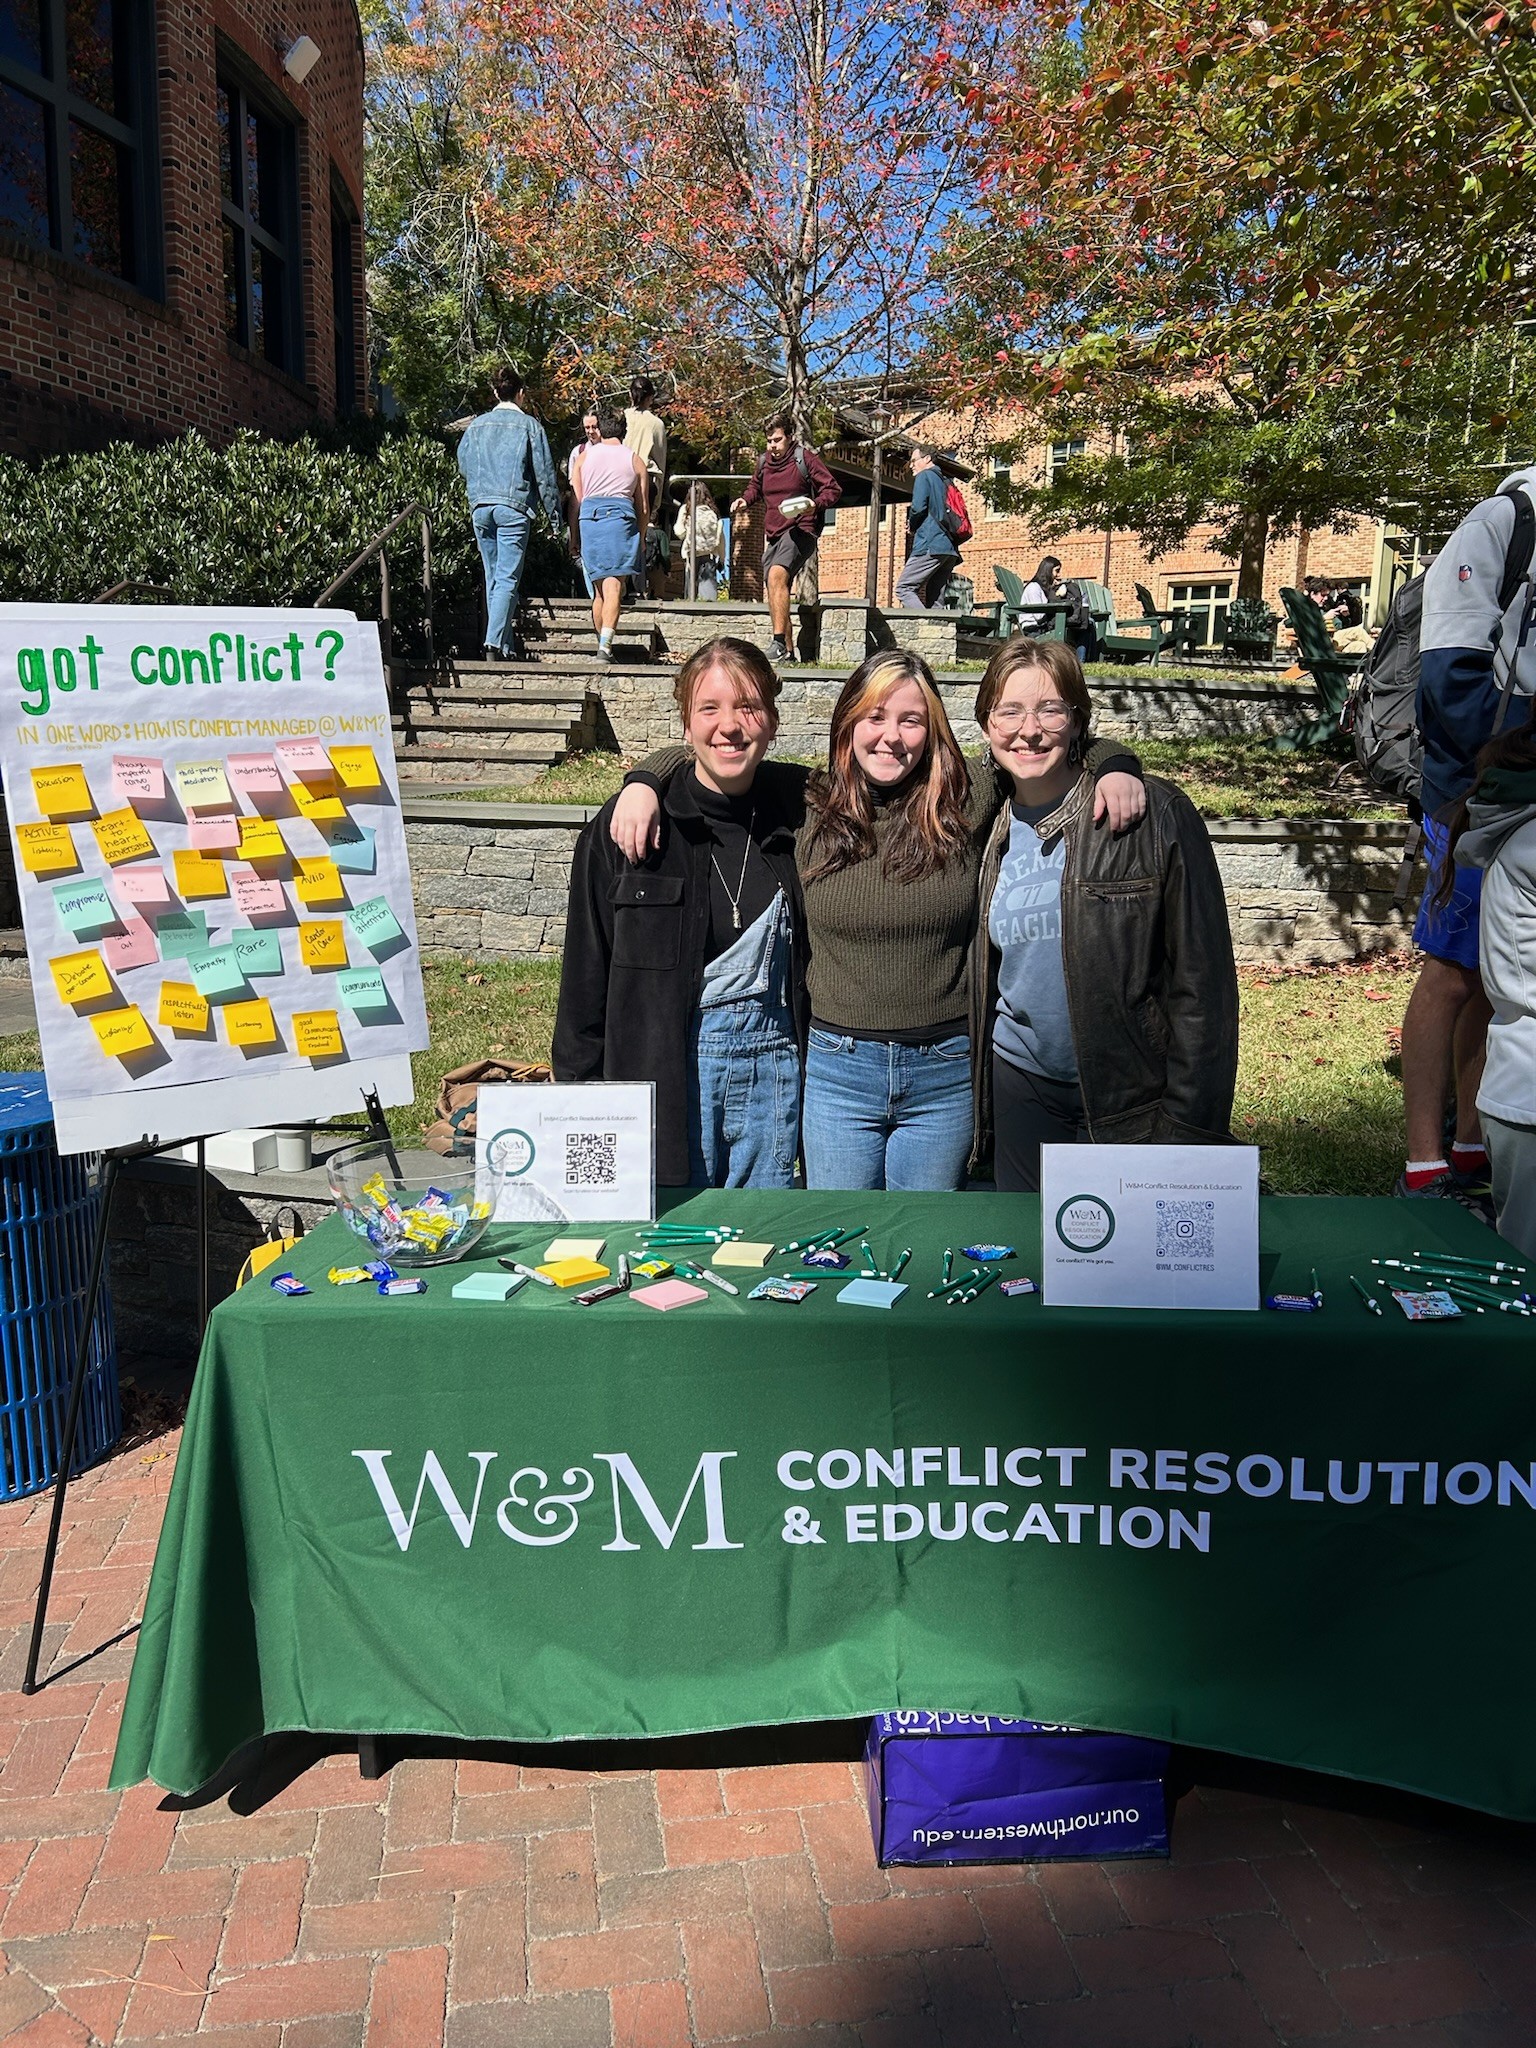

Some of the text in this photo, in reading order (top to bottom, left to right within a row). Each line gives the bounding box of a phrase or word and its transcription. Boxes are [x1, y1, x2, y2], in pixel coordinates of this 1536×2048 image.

[17, 634, 104, 717] got
[17, 725, 40, 745] IN
[46, 724, 77, 745] ONE
[134, 721, 172, 741] HOW
[172, 719, 188, 738] IS
[246, 717, 317, 738] MANAGED
[24, 827, 62, 839] ACTIVE
[1022, 883, 1045, 908] 77
[349, 901, 379, 924] needs
[236, 938, 267, 959] Rare
[1069, 1209, 1101, 1220] W&M
[777, 1446, 1536, 1510] CONFLICT RESOLUTION
[351, 1449, 744, 1552] W&M
[782, 1502, 1212, 1553] & EDUCATION
[911, 1808, 1140, 1846] our.northwestern.edu
